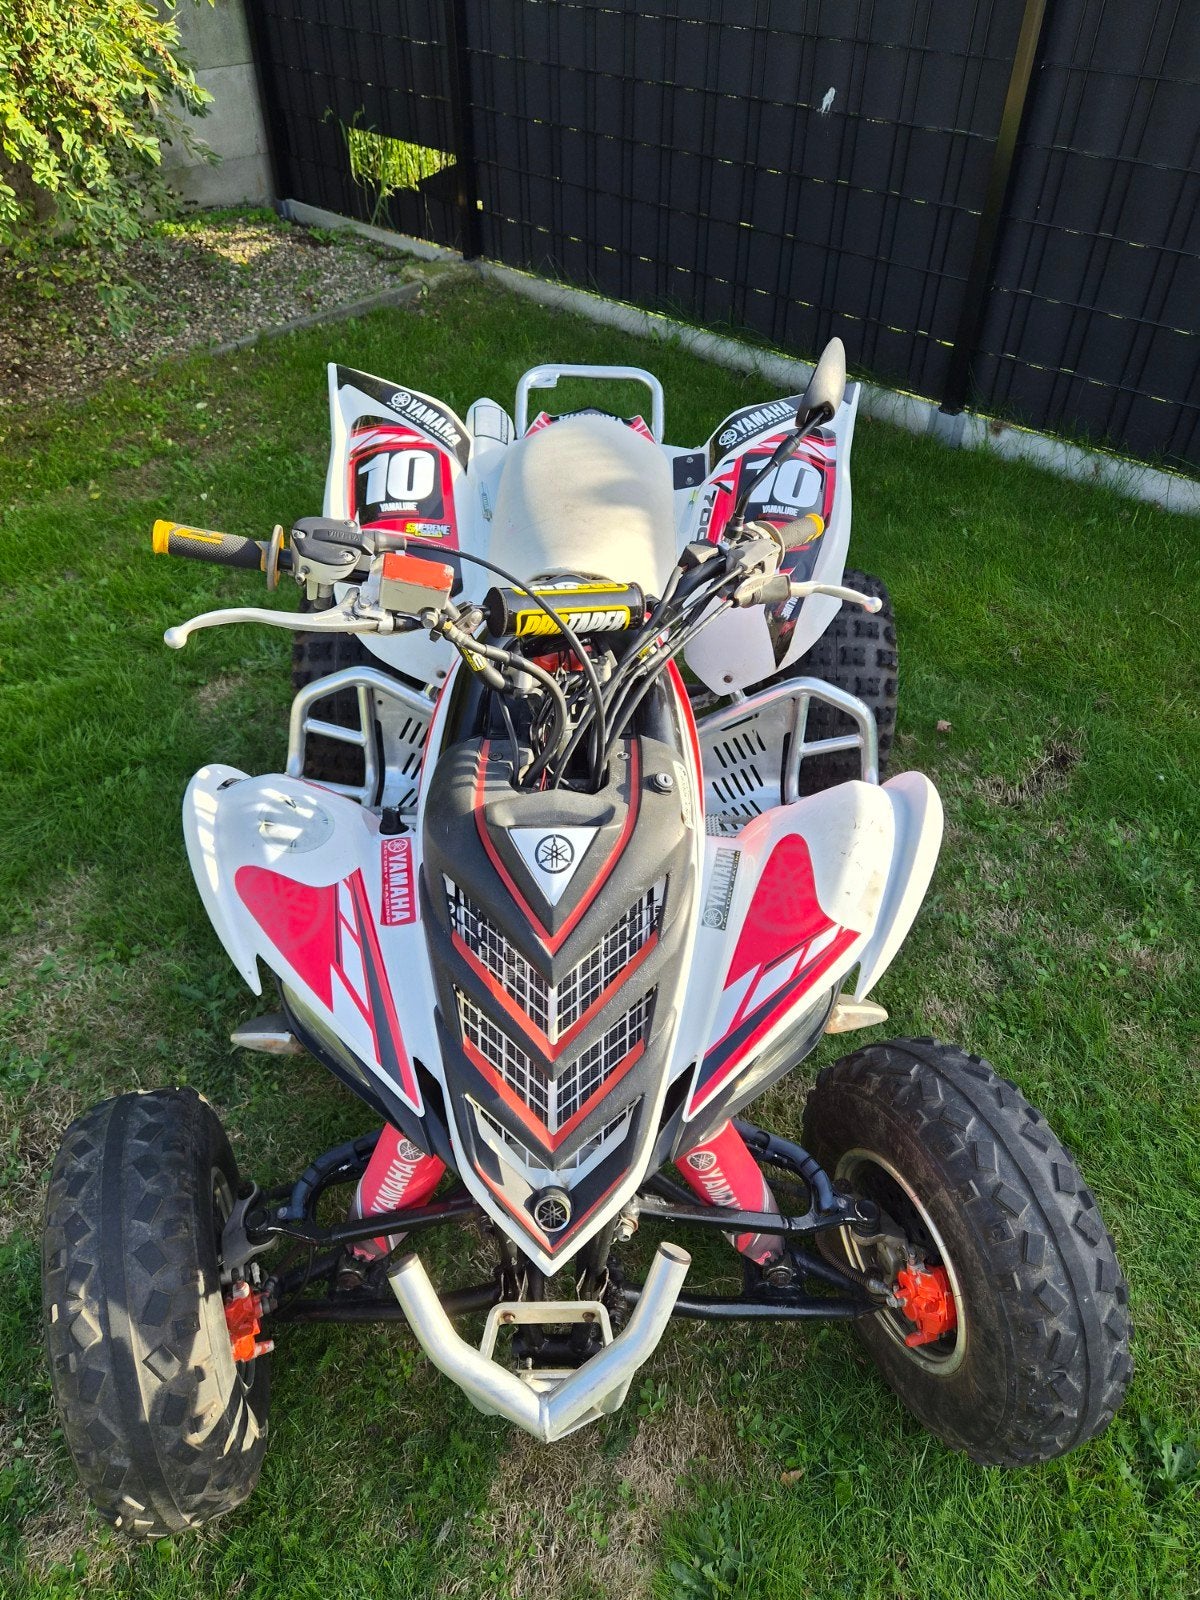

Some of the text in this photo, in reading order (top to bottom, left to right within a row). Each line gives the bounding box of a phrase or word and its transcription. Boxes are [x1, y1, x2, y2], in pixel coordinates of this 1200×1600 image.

[386, 401, 455, 447] FACTORY RACING
[406, 399, 462, 447] YAMAHA
[726, 425, 766, 448] FACTORY
[732, 401, 795, 434] YAMAHA
[358, 449, 436, 506] 10
[745, 456, 822, 508] 10
[379, 501, 418, 512] YAMALUBE
[762, 504, 800, 517] YAMALUBE
[388, 852, 410, 922] YAMAHA
[706, 847, 736, 906] YAMAHA
[722, 886, 733, 929] FACTORY
[370, 1158, 417, 1213] YAMAHA
